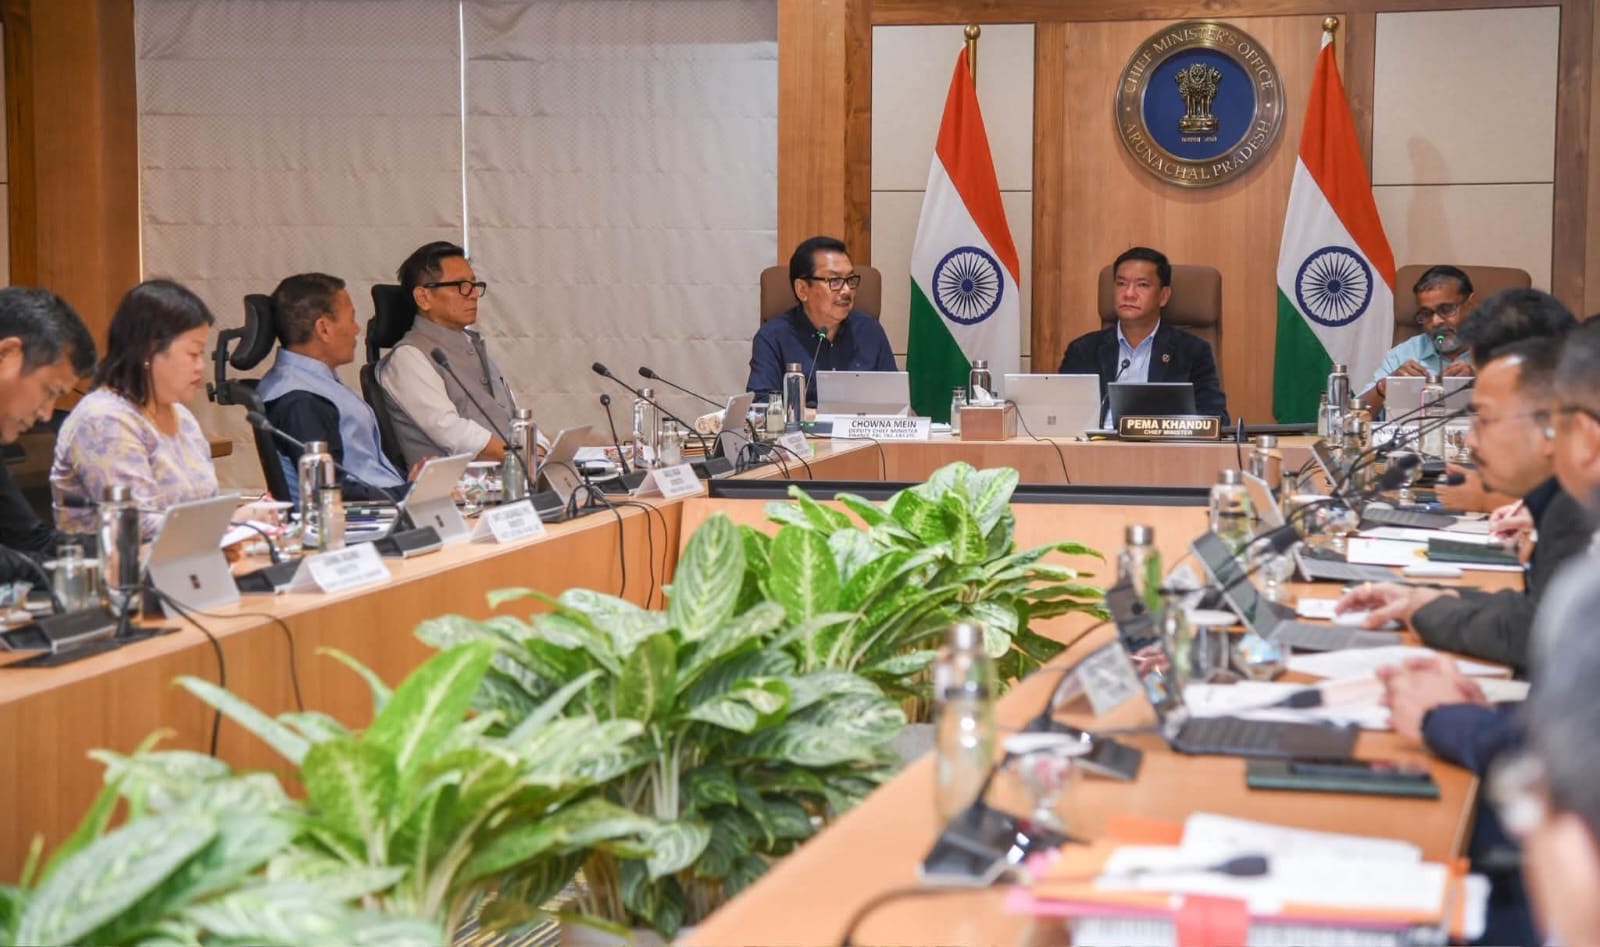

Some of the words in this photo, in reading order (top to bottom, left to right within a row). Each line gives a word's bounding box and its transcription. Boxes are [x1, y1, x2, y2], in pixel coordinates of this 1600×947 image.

[1125, 49, 1153, 93] CHIEF
[1152, 29, 1238, 54] MINISTER'S
[1238, 42, 1274, 91] OFFICE
[1126, 123, 1210, 180] ARUNACHAL
[1211, 120, 1271, 177] PRADESH
[851, 420, 891, 428] CHOWNA
[893, 420, 917, 428] MEIN
[1127, 419, 1159, 429] PEMA
[1162, 420, 1212, 430] KHANDU
